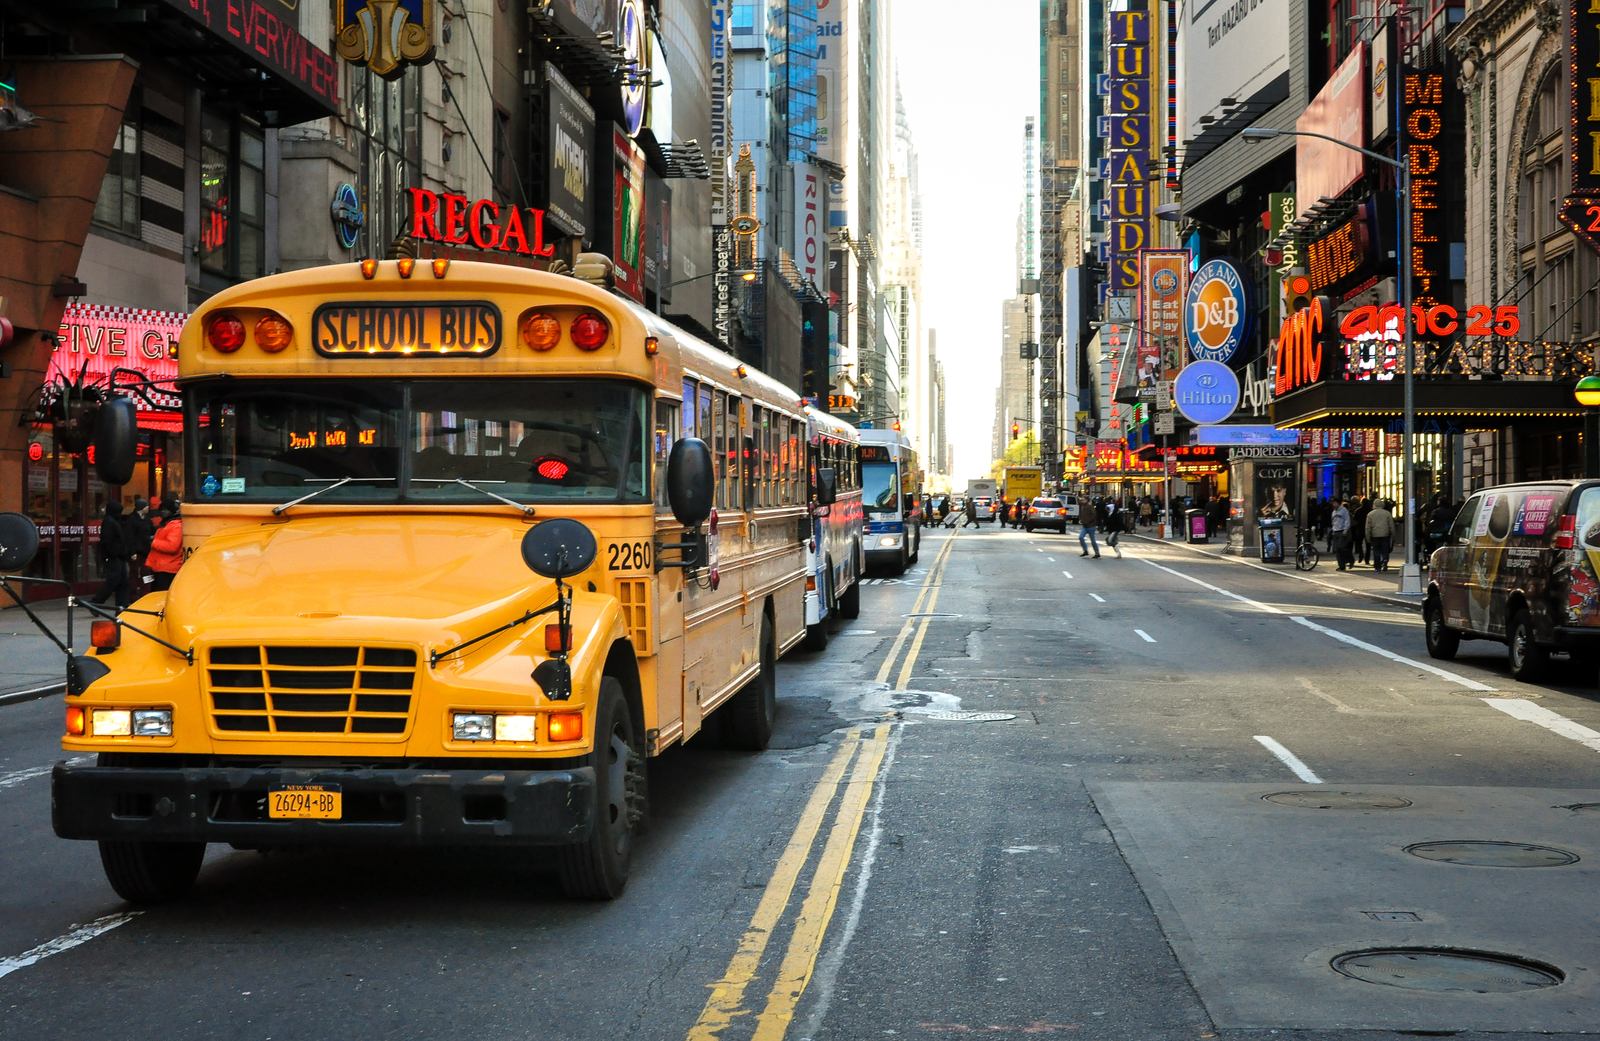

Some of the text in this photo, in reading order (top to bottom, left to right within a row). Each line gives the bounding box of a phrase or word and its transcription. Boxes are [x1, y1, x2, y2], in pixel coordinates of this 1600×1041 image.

[1116, 12, 1144, 288] TUSSAUD'S
[409, 187, 555, 257] REGAL
[1192, 264, 1239, 296] DAVE AND
[322, 307, 495, 350] SCHOOL BUS
[1152, 311, 1179, 320] Dink
[1152, 322, 1179, 332] Pay
[1192, 296, 1239, 334] D&B
[1466, 305, 1521, 337] 25
[53, 323, 128, 357] FIVE
[1182, 391, 1233, 405] Hilton
[1259, 468, 1293, 478] CLYDE
[1525, 512, 1548, 521] COFFEE
[608, 541, 650, 571] 2260
[275, 794, 311, 812] 26294
